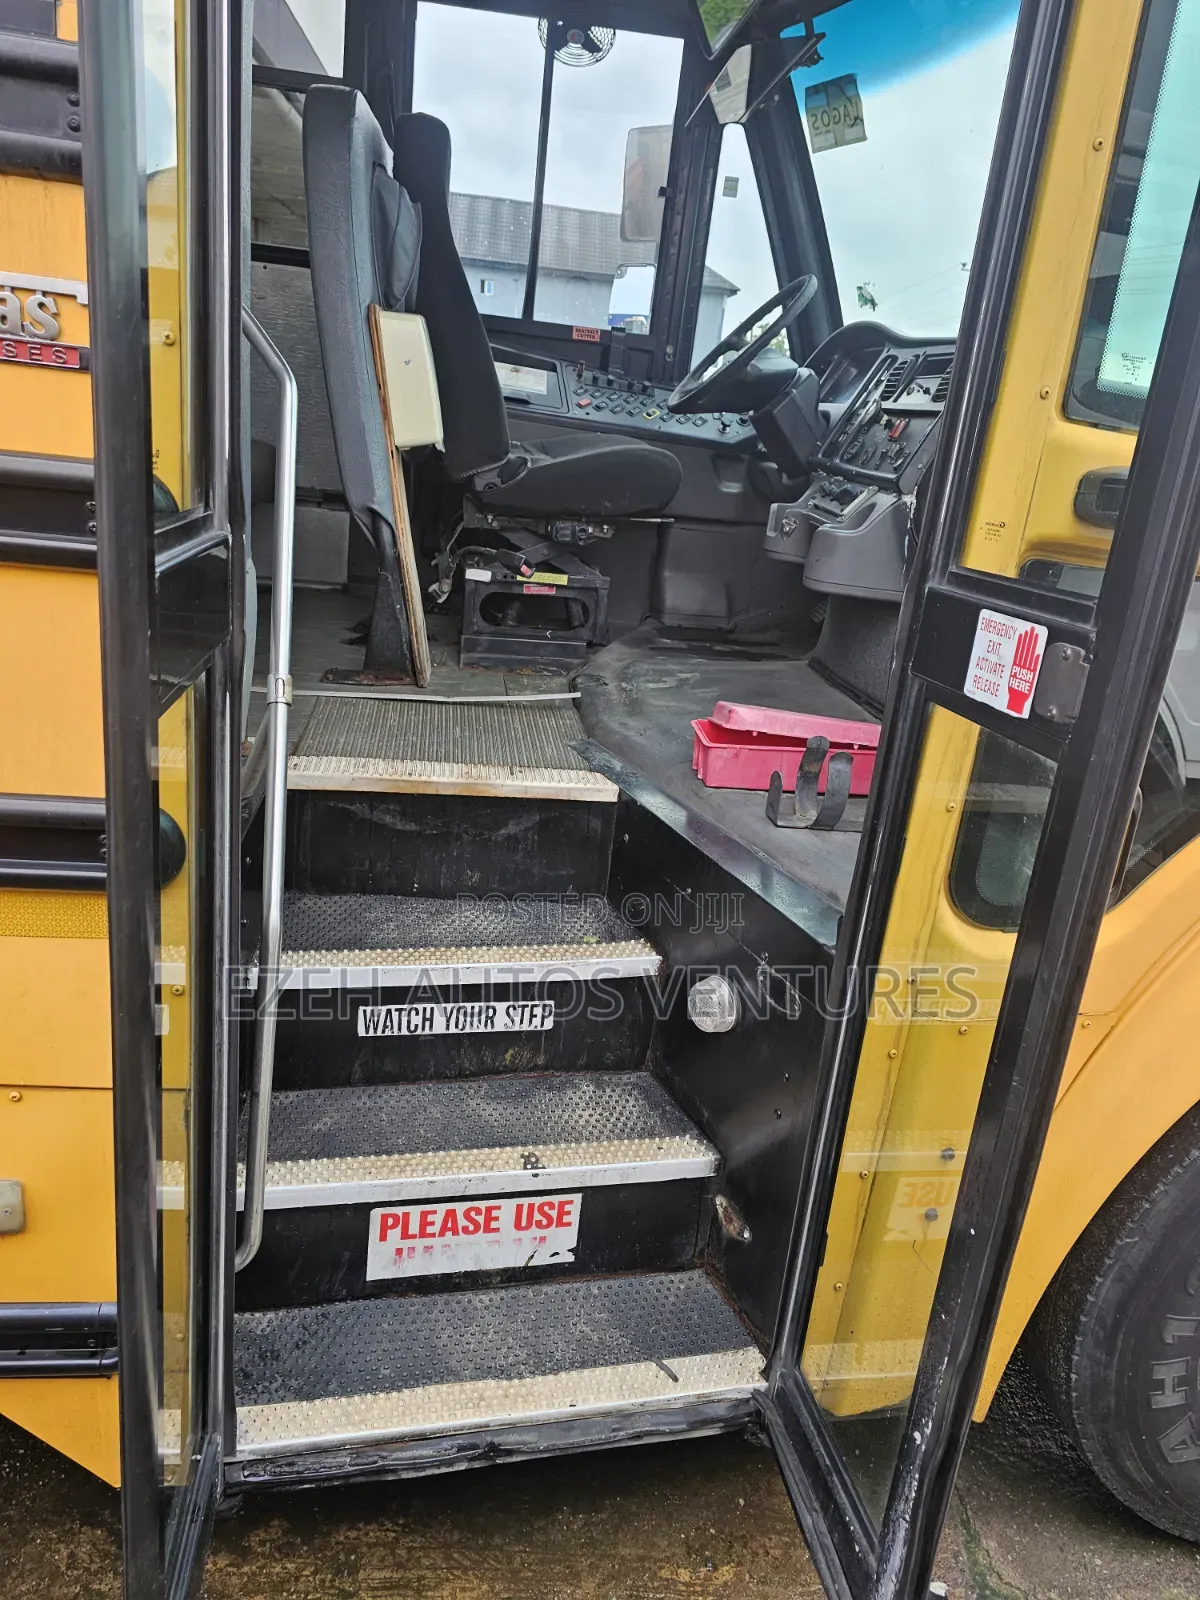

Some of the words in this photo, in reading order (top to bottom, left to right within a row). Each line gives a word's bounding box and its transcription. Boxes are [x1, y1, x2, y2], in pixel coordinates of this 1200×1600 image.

[980, 617, 1018, 640] EMERGENCY
[986, 640, 1002, 656] EXIT
[975, 656, 1005, 679] ACTIVATE
[1011, 665, 1034, 680] PUSH
[972, 674, 1001, 697] RELEASE
[1009, 676, 1031, 694] HERE
[362, 1006, 435, 1035] WATCH
[443, 1005, 497, 1032] YOUR
[504, 1003, 553, 1030] STEP
[378, 1204, 502, 1242] PLEASE
[513, 1199, 574, 1232] USE
